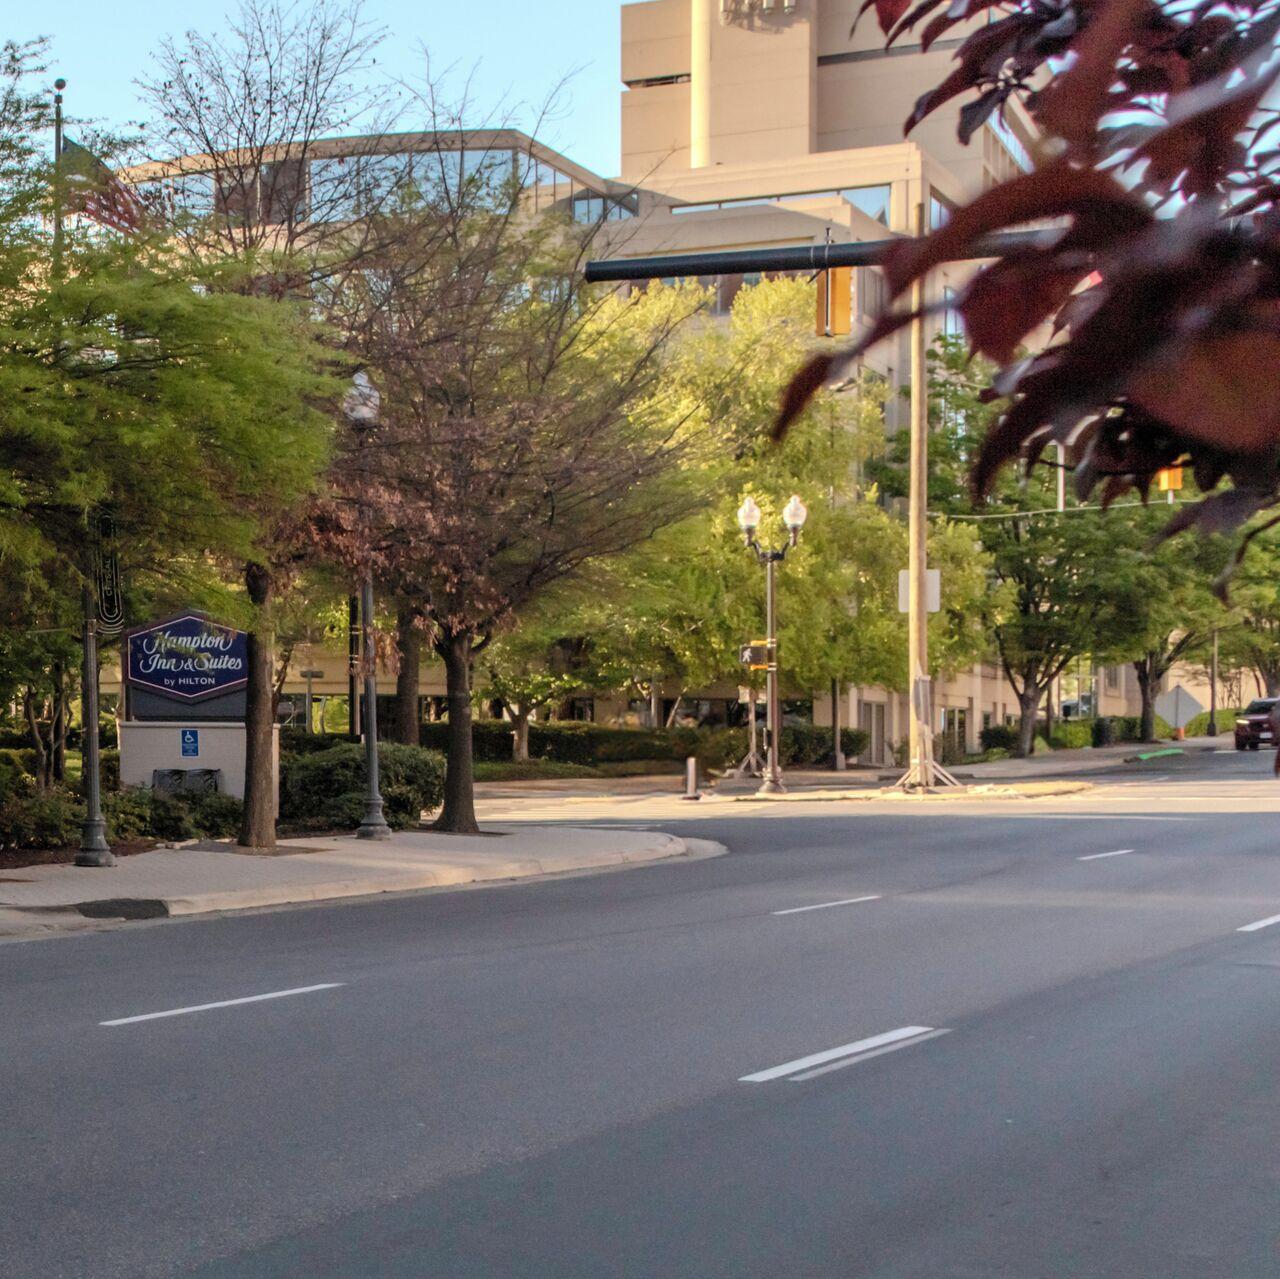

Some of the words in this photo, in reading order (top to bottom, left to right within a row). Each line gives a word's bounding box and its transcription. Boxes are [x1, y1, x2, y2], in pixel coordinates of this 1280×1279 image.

[143, 631, 233, 655] Hampton
[140, 653, 184, 673] Inn
[184, 658, 196, 671] &
[194, 652, 242, 670] Suites
[164, 677, 175, 686] by
[178, 677, 215, 685] HILTON
